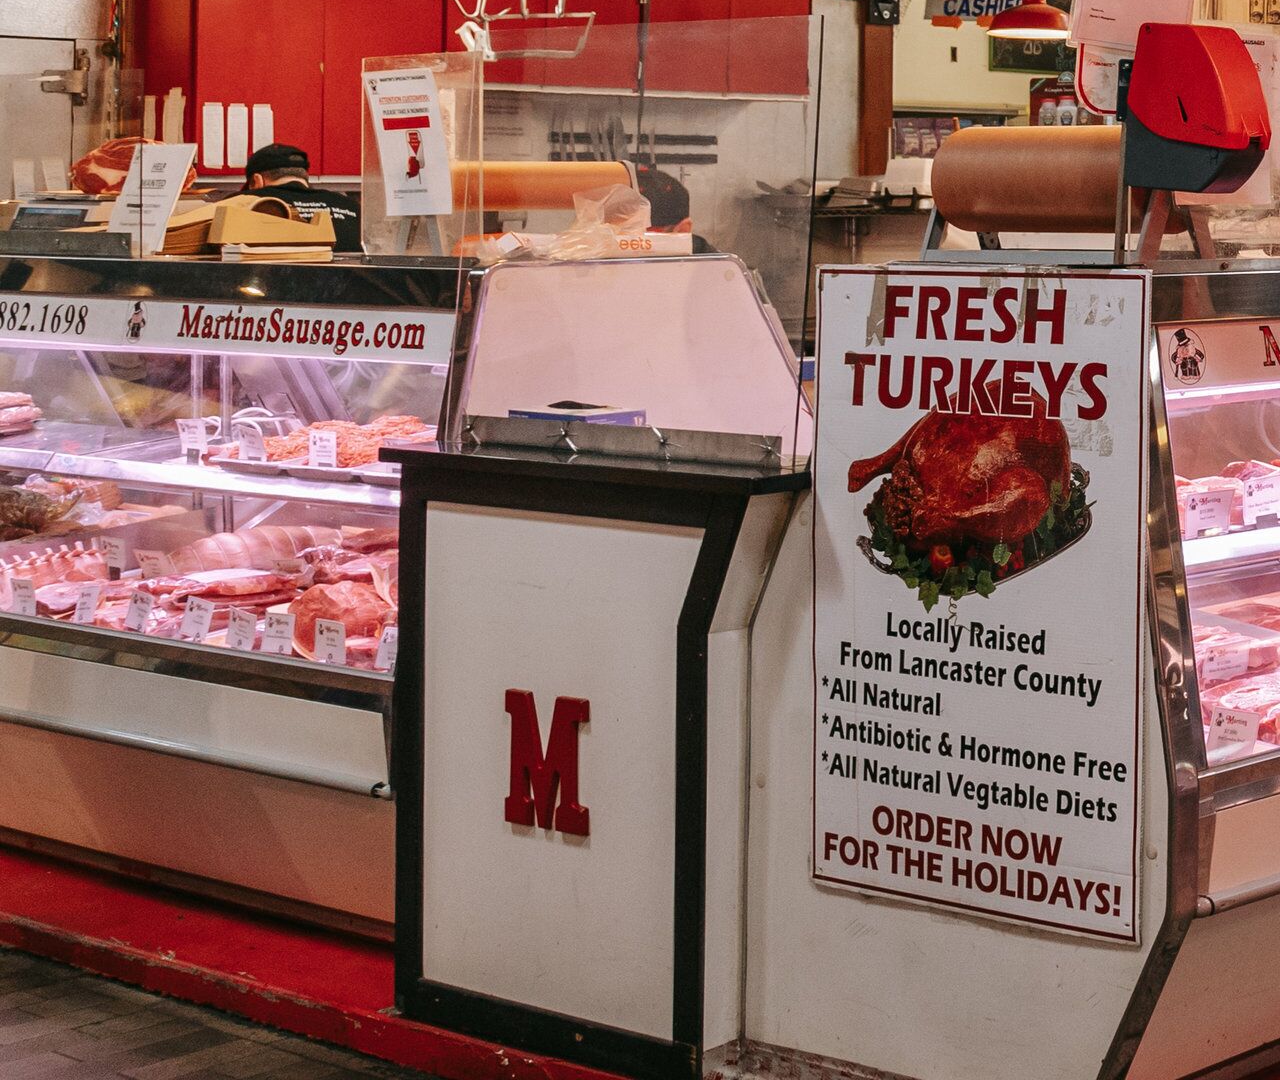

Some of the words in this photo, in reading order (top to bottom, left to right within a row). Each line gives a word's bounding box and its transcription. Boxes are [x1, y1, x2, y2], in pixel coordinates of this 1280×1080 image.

[178, 304, 426, 355] MartinsSausage.com
[884, 285, 1067, 345] FRESH
[845, 353, 1108, 421] TURKEYS
[885, 612, 962, 653] Locally
[970, 621, 1046, 656] Raised
[839, 641, 893, 673] From
[899, 648, 1006, 689] Lancaster
[1013, 663, 1102, 707] County
[862, 685, 942, 717] Natural
[505, 688, 590, 836] M
[938, 732, 953, 757] &
[960, 736, 1066, 775] Hormone
[1073, 749, 1128, 783] Free
[862, 758, 941, 796] Natural
[947, 770, 1049, 817] Vegtable
[1056, 786, 1118, 823] Diets
[871, 805, 970, 849] ORDER
[980, 825, 1063, 867] NOW
[823, 831, 879, 870] FOR
[885, 845, 944, 883] THE
[951, 854, 1123, 917] HOLIDAYS!
